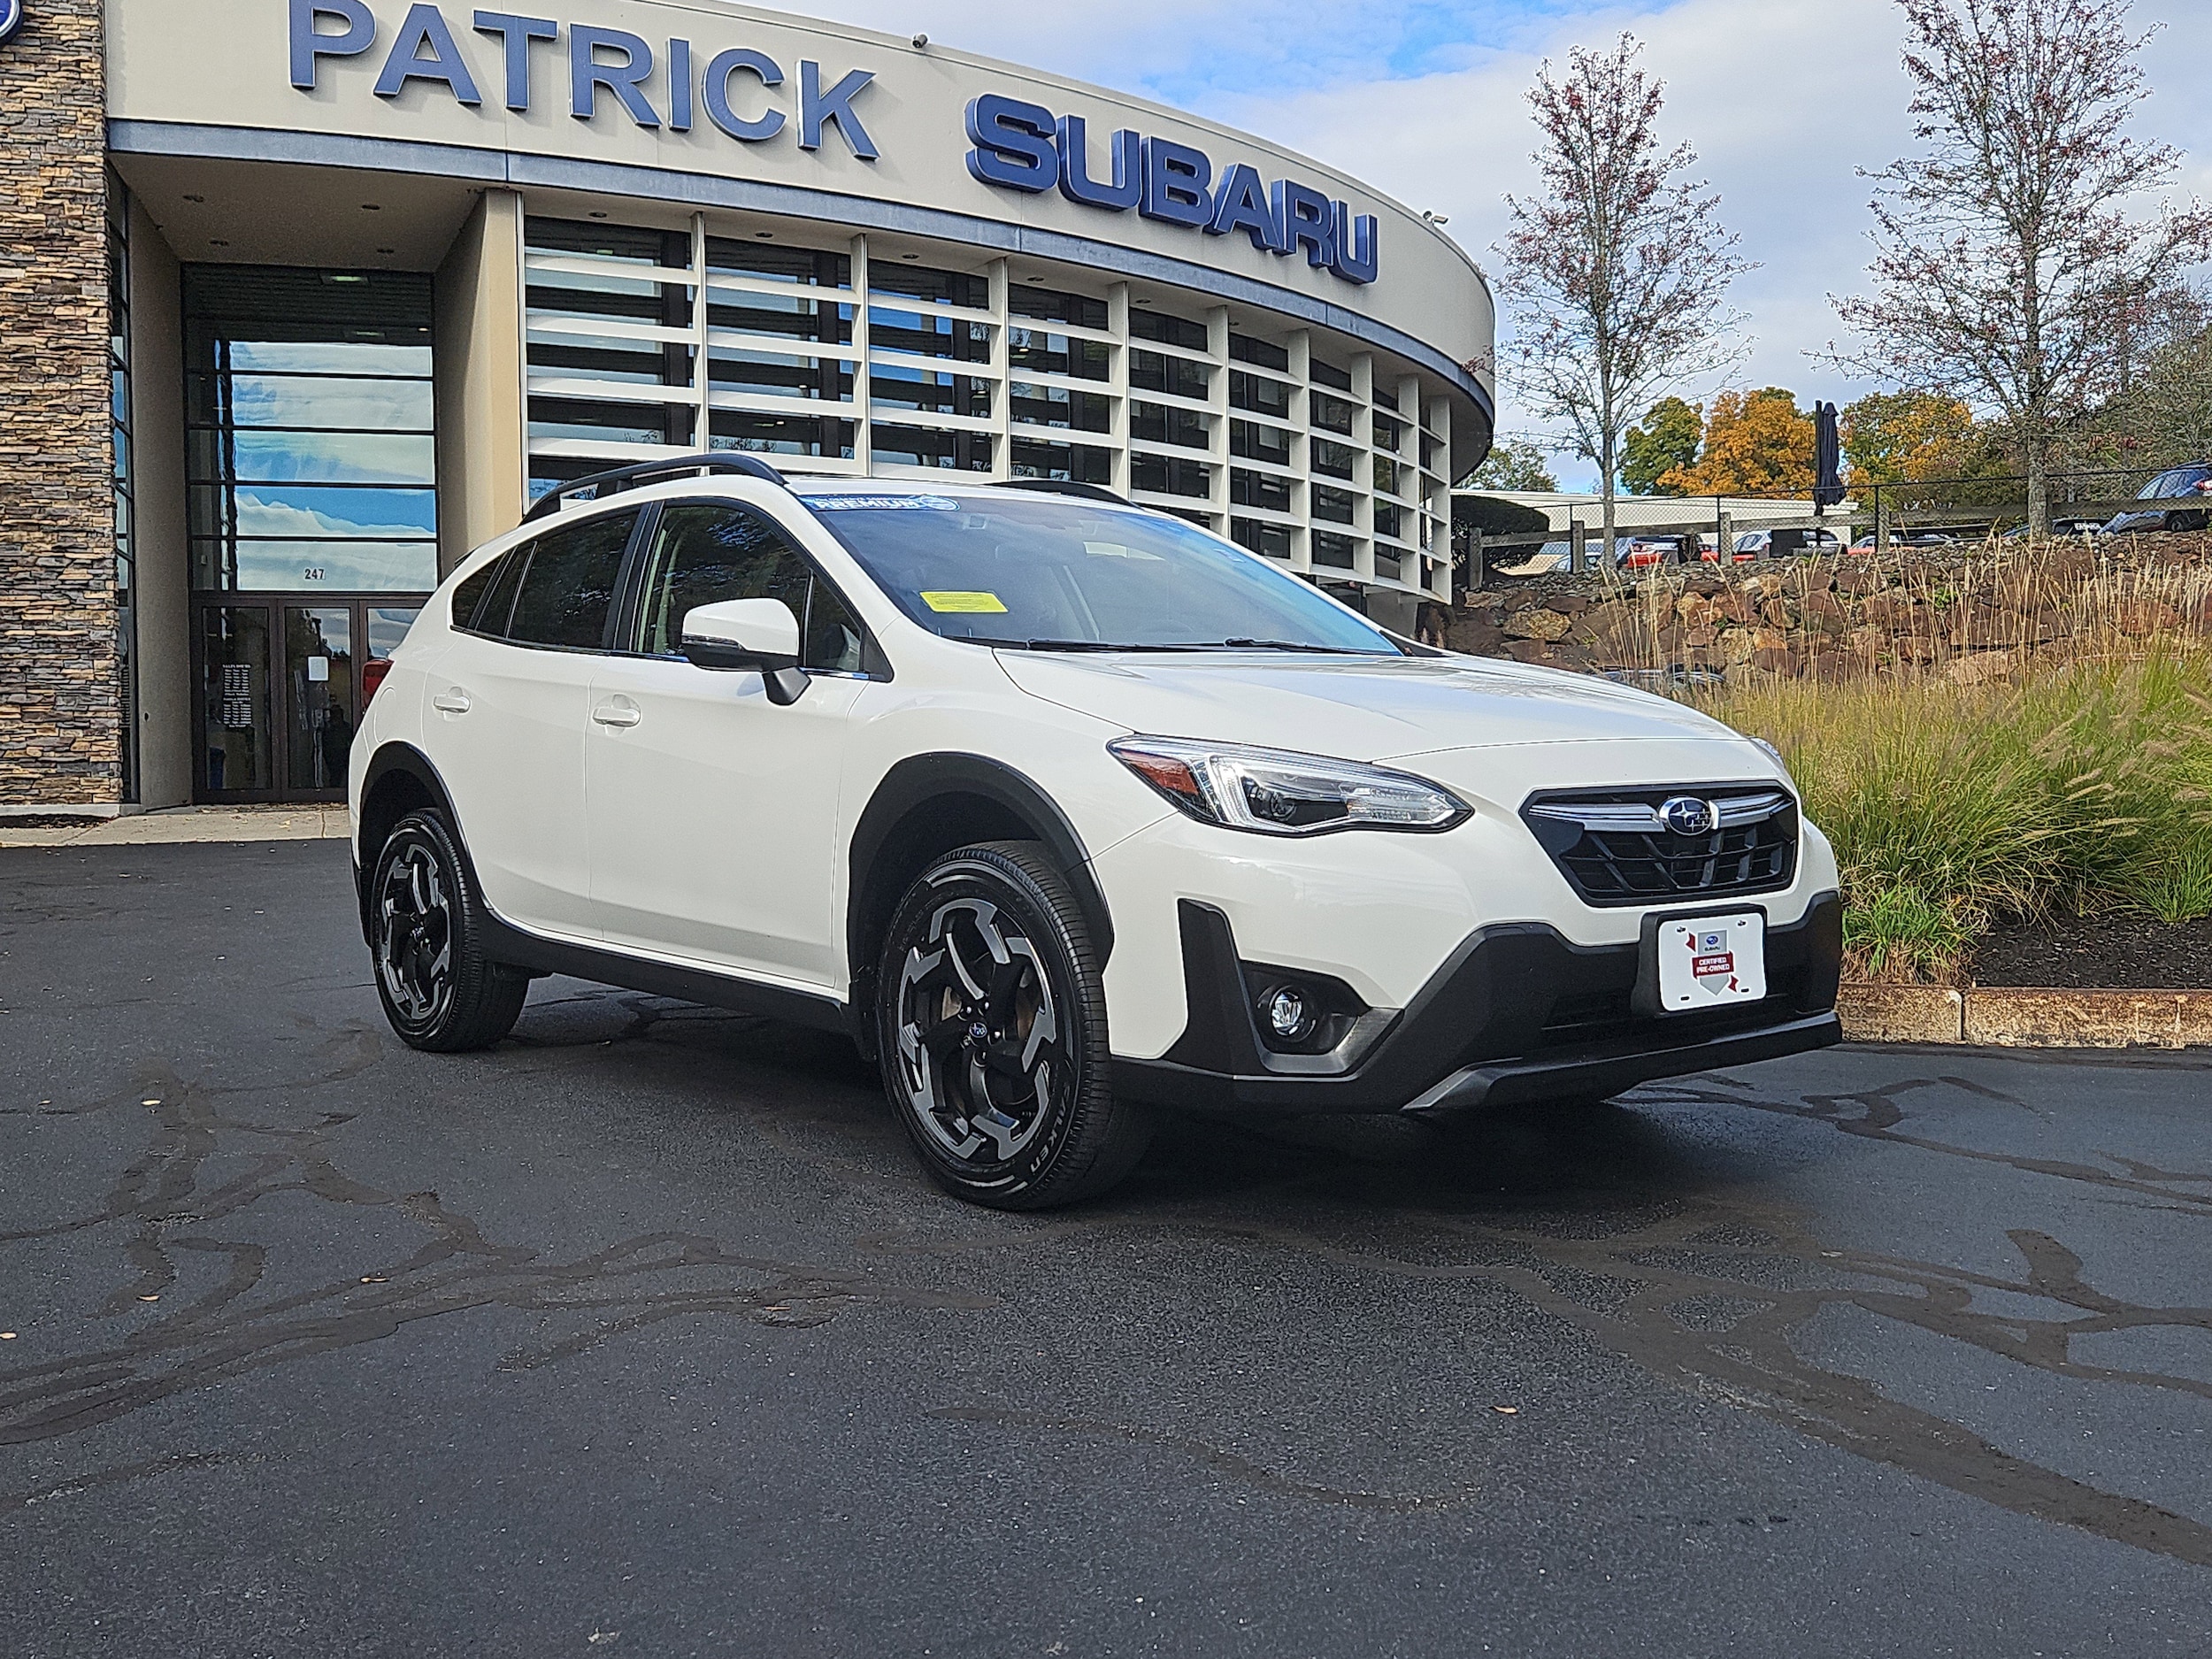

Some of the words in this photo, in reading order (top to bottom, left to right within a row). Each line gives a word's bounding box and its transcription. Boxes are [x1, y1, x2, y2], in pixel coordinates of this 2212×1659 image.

[289, 0, 879, 160] PATRICK
[964, 93, 1379, 284] SUBARU
[304, 568, 325, 580] 247
[1696, 964, 1730, 973] PRE-OWNED
